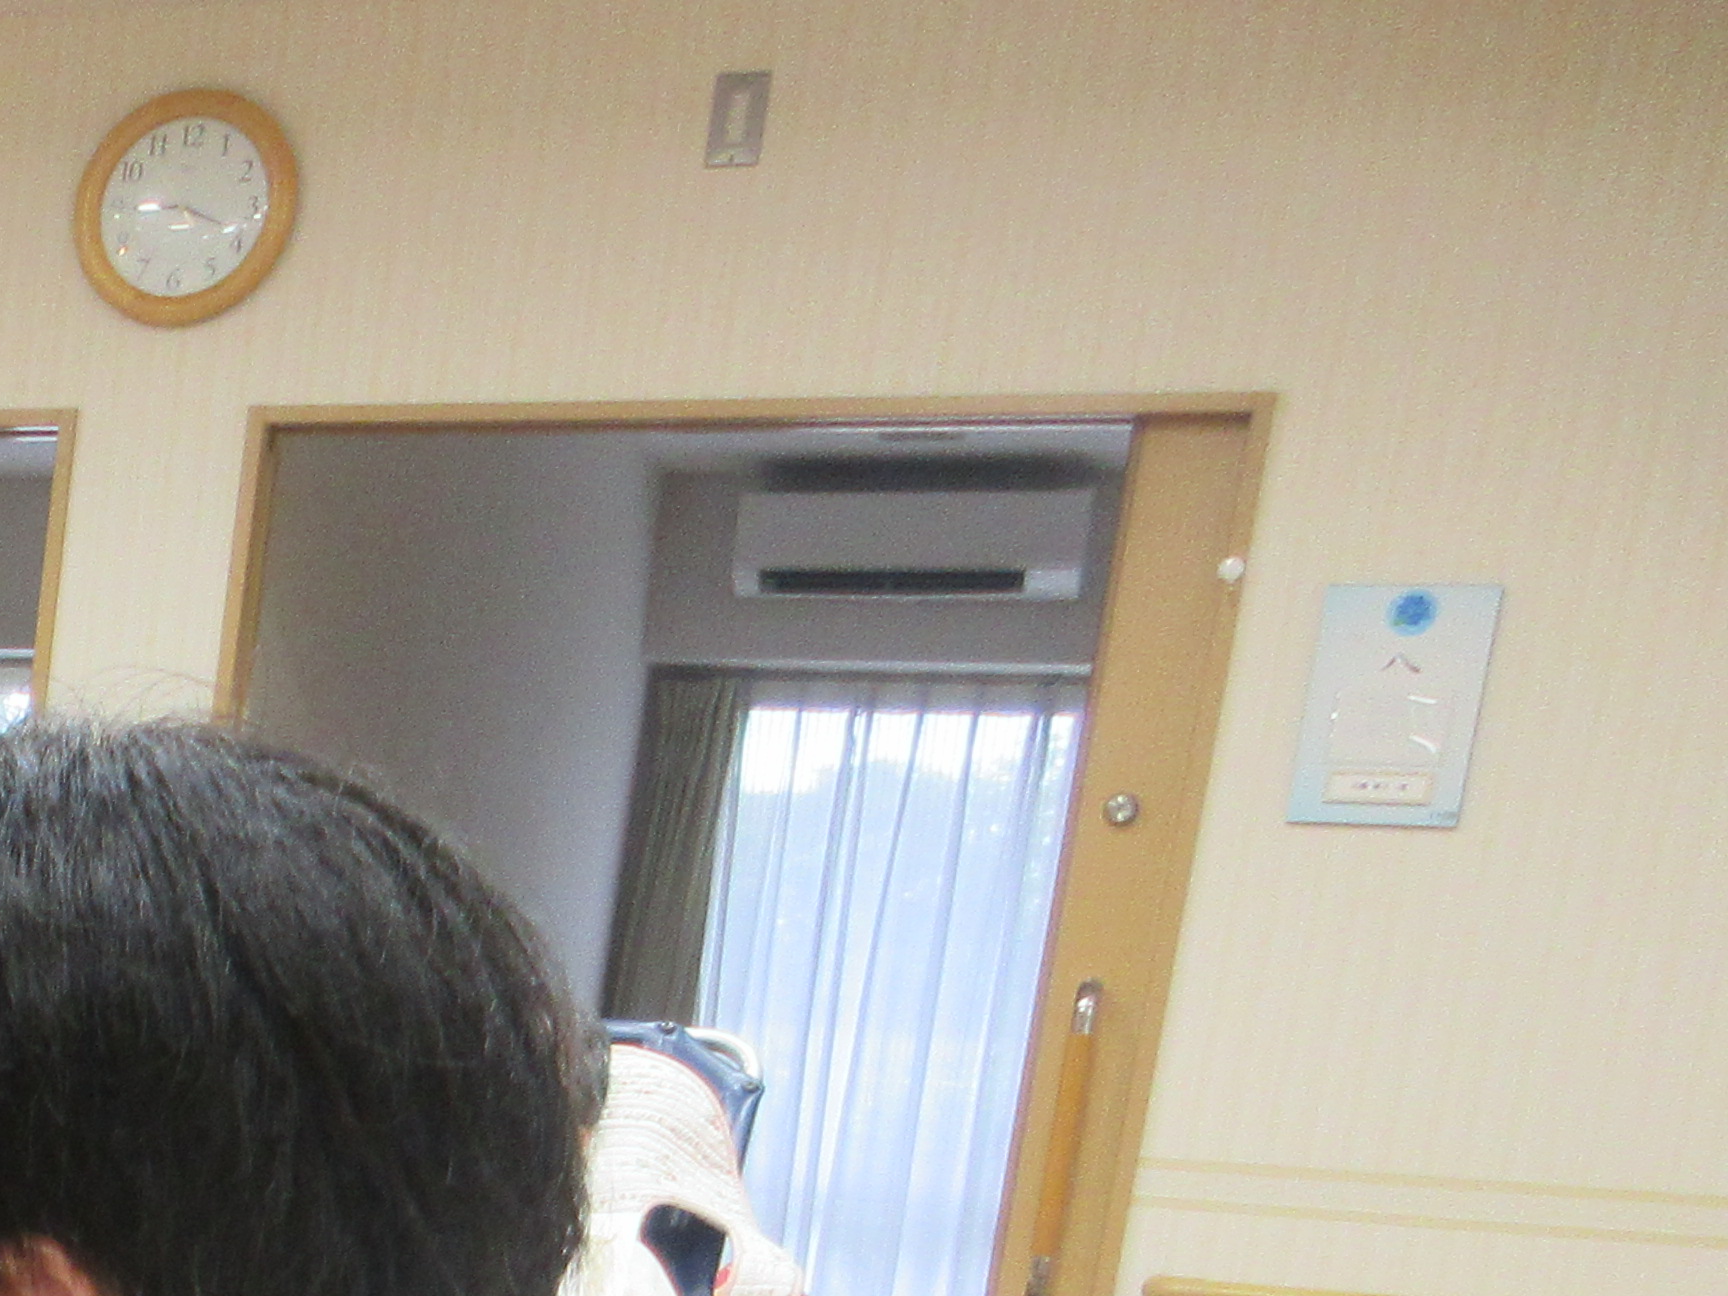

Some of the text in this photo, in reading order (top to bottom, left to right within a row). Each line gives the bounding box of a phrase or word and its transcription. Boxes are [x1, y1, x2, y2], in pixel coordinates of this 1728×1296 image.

[148, 133, 167, 157] 11
[182, 124, 205, 147] 12
[221, 133, 230, 157] 1
[122, 159, 143, 182] 10
[239, 159, 254, 182] 2
